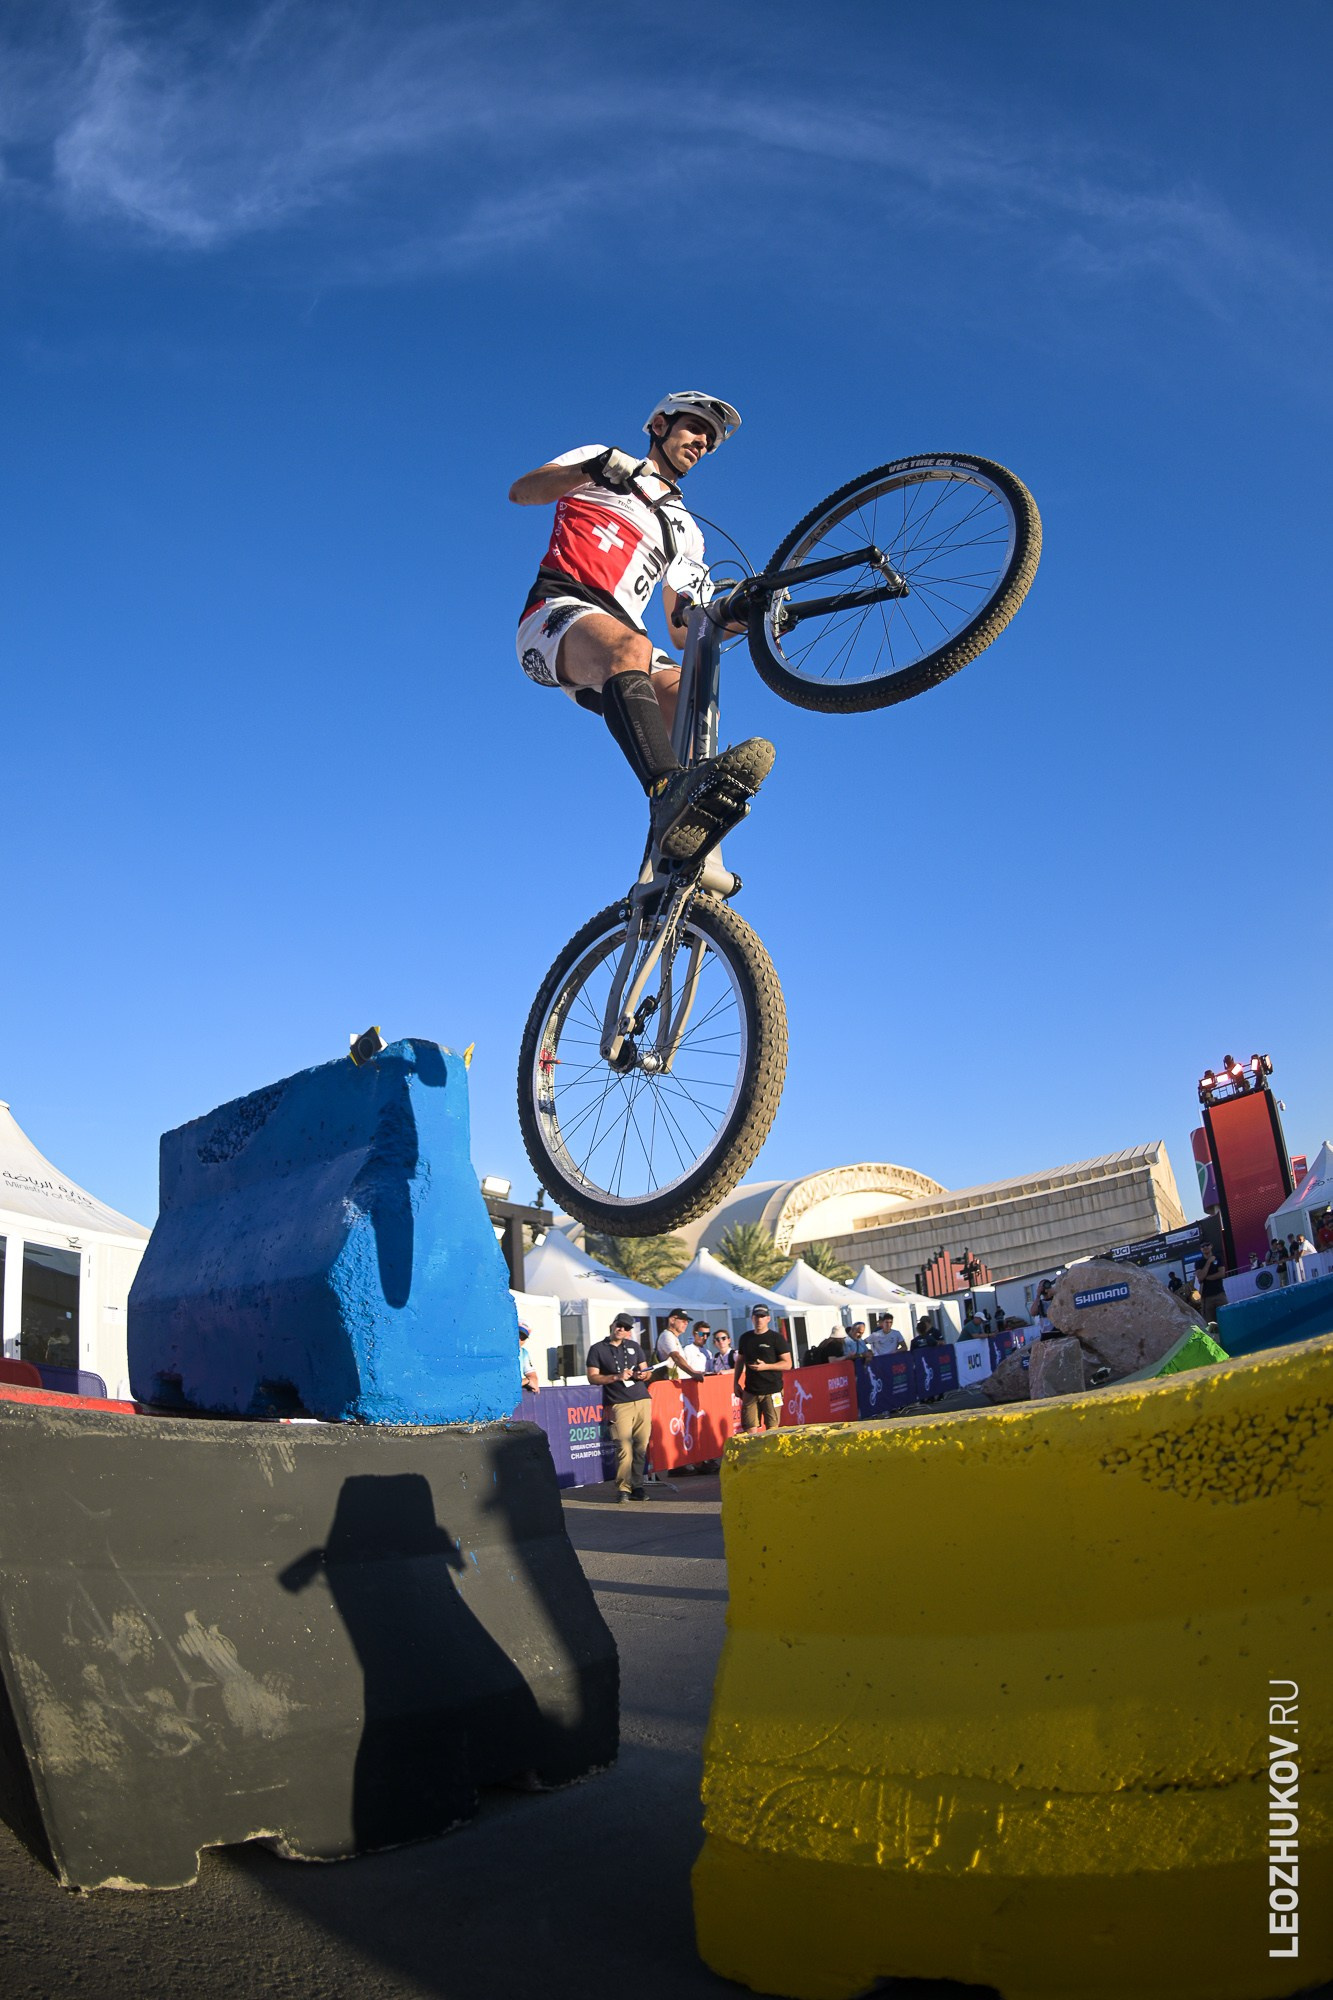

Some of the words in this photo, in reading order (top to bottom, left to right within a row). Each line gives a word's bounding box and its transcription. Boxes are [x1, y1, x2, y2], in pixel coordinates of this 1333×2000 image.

[1115, 1247, 1129, 1256] UCI
[1148, 1253, 1167, 1262] START
[1075, 1286, 1128, 1305] SHIMANO
[970, 1353, 982, 1369] UCI
[567, 1404, 604, 1424] RIYAD
[569, 1427, 597, 1442] 2025
